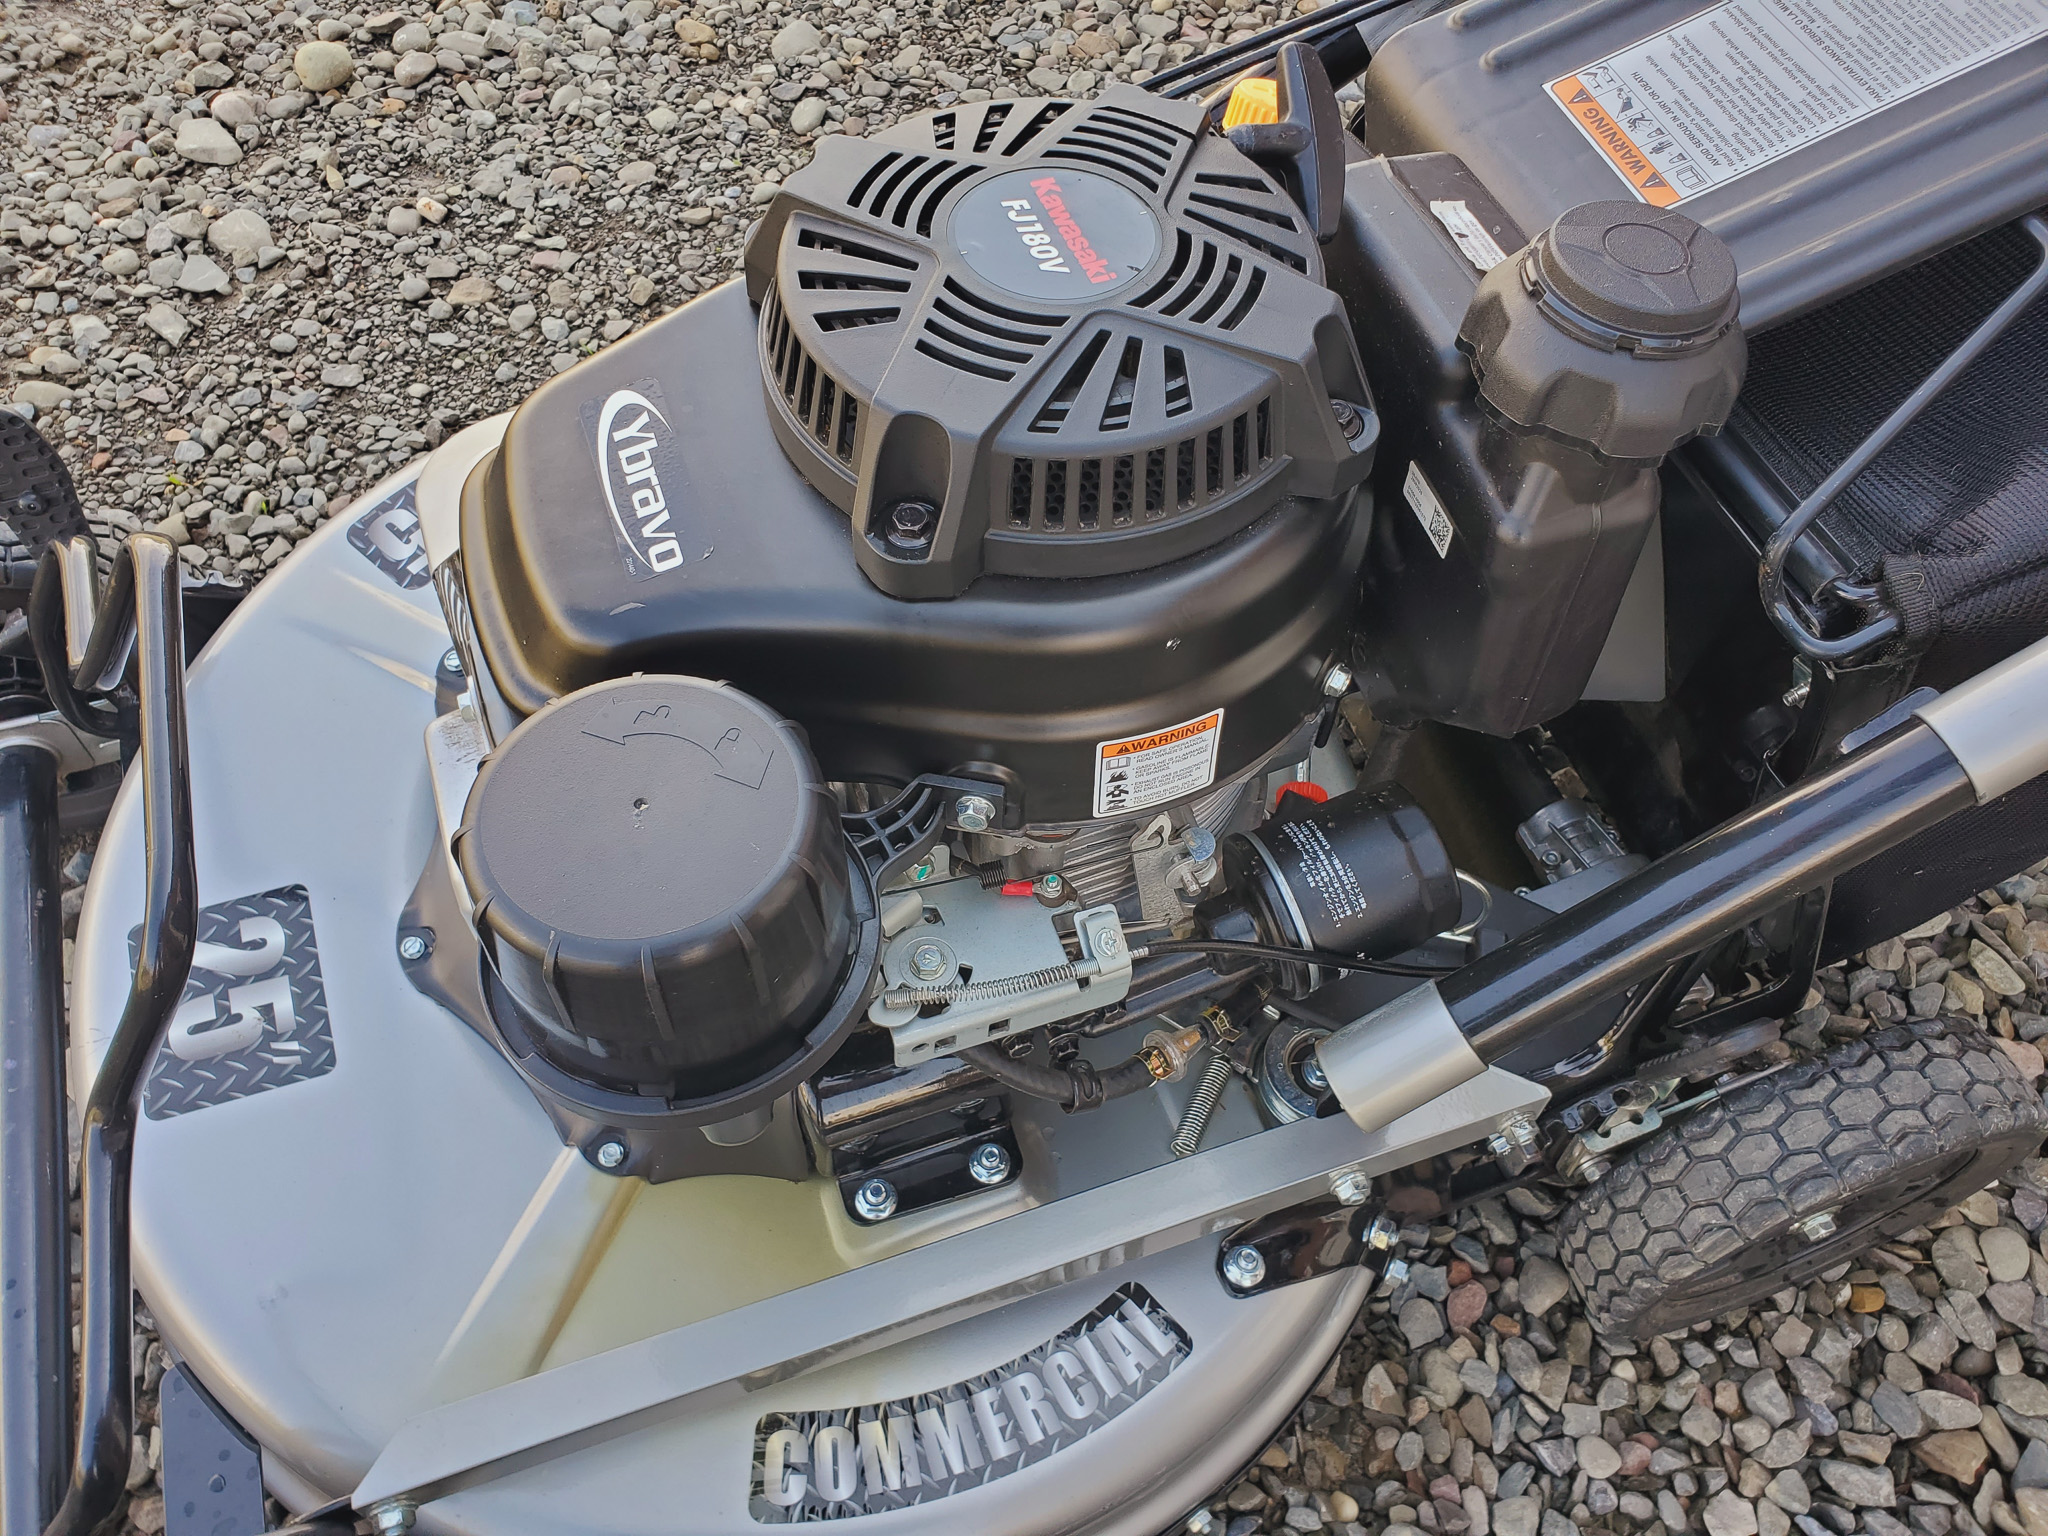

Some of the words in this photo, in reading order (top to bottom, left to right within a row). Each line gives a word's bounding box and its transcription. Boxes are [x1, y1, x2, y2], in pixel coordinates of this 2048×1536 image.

[1732, 4, 1759, 27] untrained
[1786, 10, 1799, 21] LA
[1794, 18, 1804, 26] O
[1708, 19, 1729, 40] moving
[1740, 25, 1750, 33] or
[1754, 25, 1765, 35] by
[1799, 23, 1826, 47] SERIOS
[1724, 37, 1740, 52] while
[1744, 30, 1769, 52] chocked
[1761, 32, 1781, 50] mower
[1678, 46, 1690, 57] the
[1685, 54, 1696, 64] by
[1735, 49, 1750, 61] and
[1765, 50, 1785, 68] unless
[1777, 47, 1789, 58] the
[1783, 55, 1795, 63] of
[1645, 54, 1660, 69] while
[1746, 59, 1765, 77] before
[1655, 66, 1669, 79] unit
[1684, 68, 1700, 83] other
[1691, 61, 1711, 80] thrown
[1735, 64, 1751, 76] and
[1781, 66, 1799, 81] slope
[1791, 60, 1818, 85] operation
[1842, 64, 1869, 88] EVITAR
[1630, 70, 1653, 92] DEATH
[1665, 76, 1680, 91] from
[1707, 78, 1718, 87] be
[1746, 74, 1757, 84] up
[1752, 80, 1766, 92] not
[1759, 74, 1781, 94] behind
[1798, 82, 1810, 92] on
[1647, 89, 1661, 101] OR
[1676, 88, 1692, 103] away
[1695, 80, 1716, 100] toward
[1712, 84, 1731, 100] could
[1776, 90, 1791, 102] and
[1805, 89, 1823, 103] park
[1813, 83, 1831, 98] allow
[1864, 84, 1886, 104] PARA
[1725, 97, 1740, 111] that
[1737, 94, 1759, 114] devices
[1752, 96, 1767, 108] and
[1787, 100, 1805, 116] down
[1816, 100, 1830, 112] not
[1826, 96, 1840, 107] not
[1687, 101, 1706, 119] others
[1712, 97, 1739, 123] discharge
[1736, 108, 1757, 128] objects
[1763, 106, 1782, 122] place
[1779, 107, 1799, 126] across
[1826, 109, 1838, 121] Do
[1836, 105, 1848, 116] Do
[1700, 116, 1716, 128] and
[1755, 112, 1774, 130] safety
[1776, 119, 1786, 128] in
[1795, 123, 1807, 135] Go
[1800, 114, 1818, 130] Look
[1676, 121, 1705, 149] SERIOUS
[1689, 117, 1716, 144] operator's
[1711, 126, 1734, 149] children
[1733, 121, 1752, 138] direct
[1753, 126, 1777, 149] Remove
[1770, 128, 1787, 144] Keep
[1583, 107, 1647, 176] WARNING
[1712, 142, 1724, 154] the
[1748, 136, 1767, 154] Never
[1699, 147, 1722, 167] AVOID
[1718, 151, 1737, 168] Read
[1730, 147, 1747, 163] Keep
[1000, 199, 1072, 274] FJ180V
[1030, 176, 1118, 285] Kawasaki
[612, 410, 685, 573] Ybravo
[1131, 721, 1207, 751] WARNING
[764, 1298, 1181, 1506] COMMERCIAL
